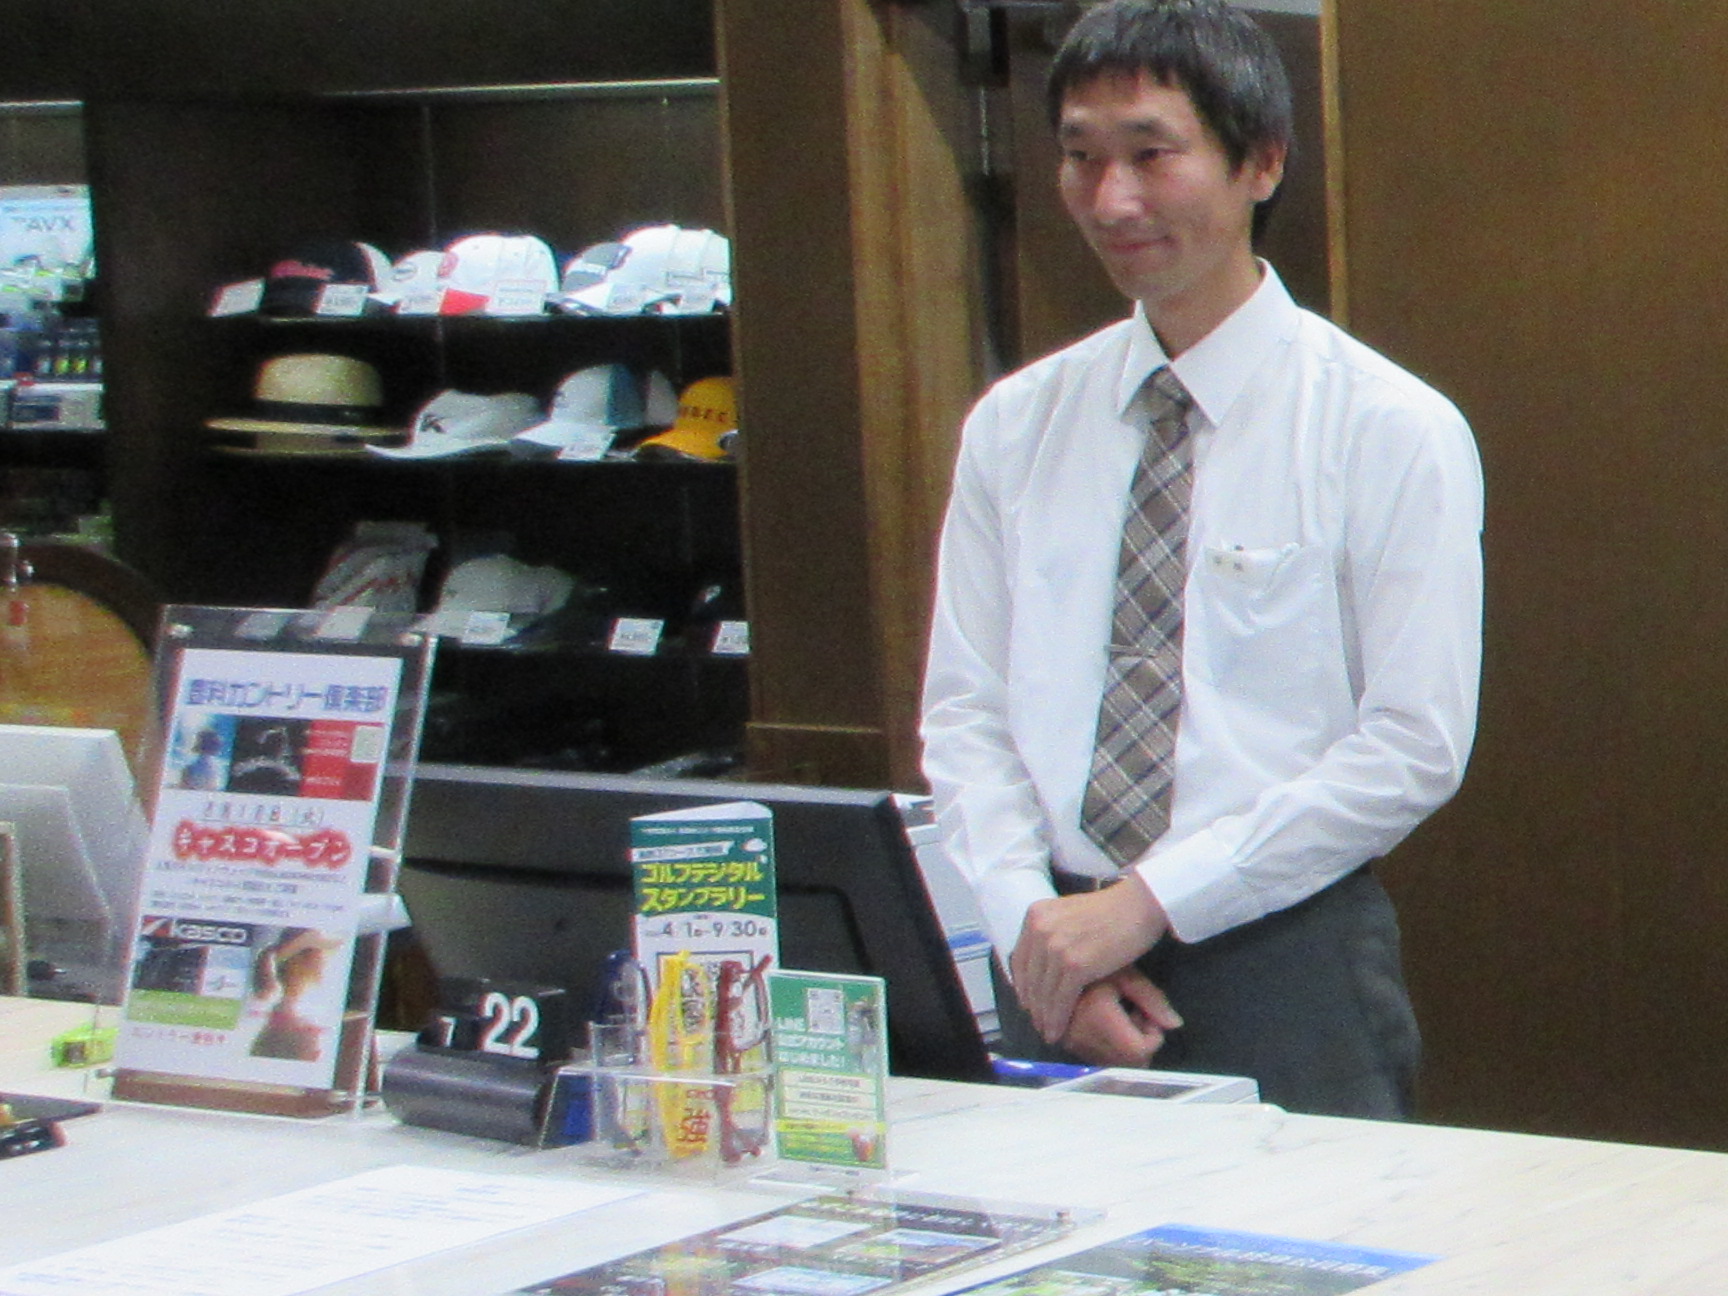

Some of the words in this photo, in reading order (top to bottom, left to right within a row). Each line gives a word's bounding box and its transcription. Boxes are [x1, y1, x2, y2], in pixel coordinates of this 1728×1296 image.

[640, 861, 764, 884] ゴルフデジタル
[640, 886, 766, 912] スタンプラリー
[481, 991, 541, 1060] 22
